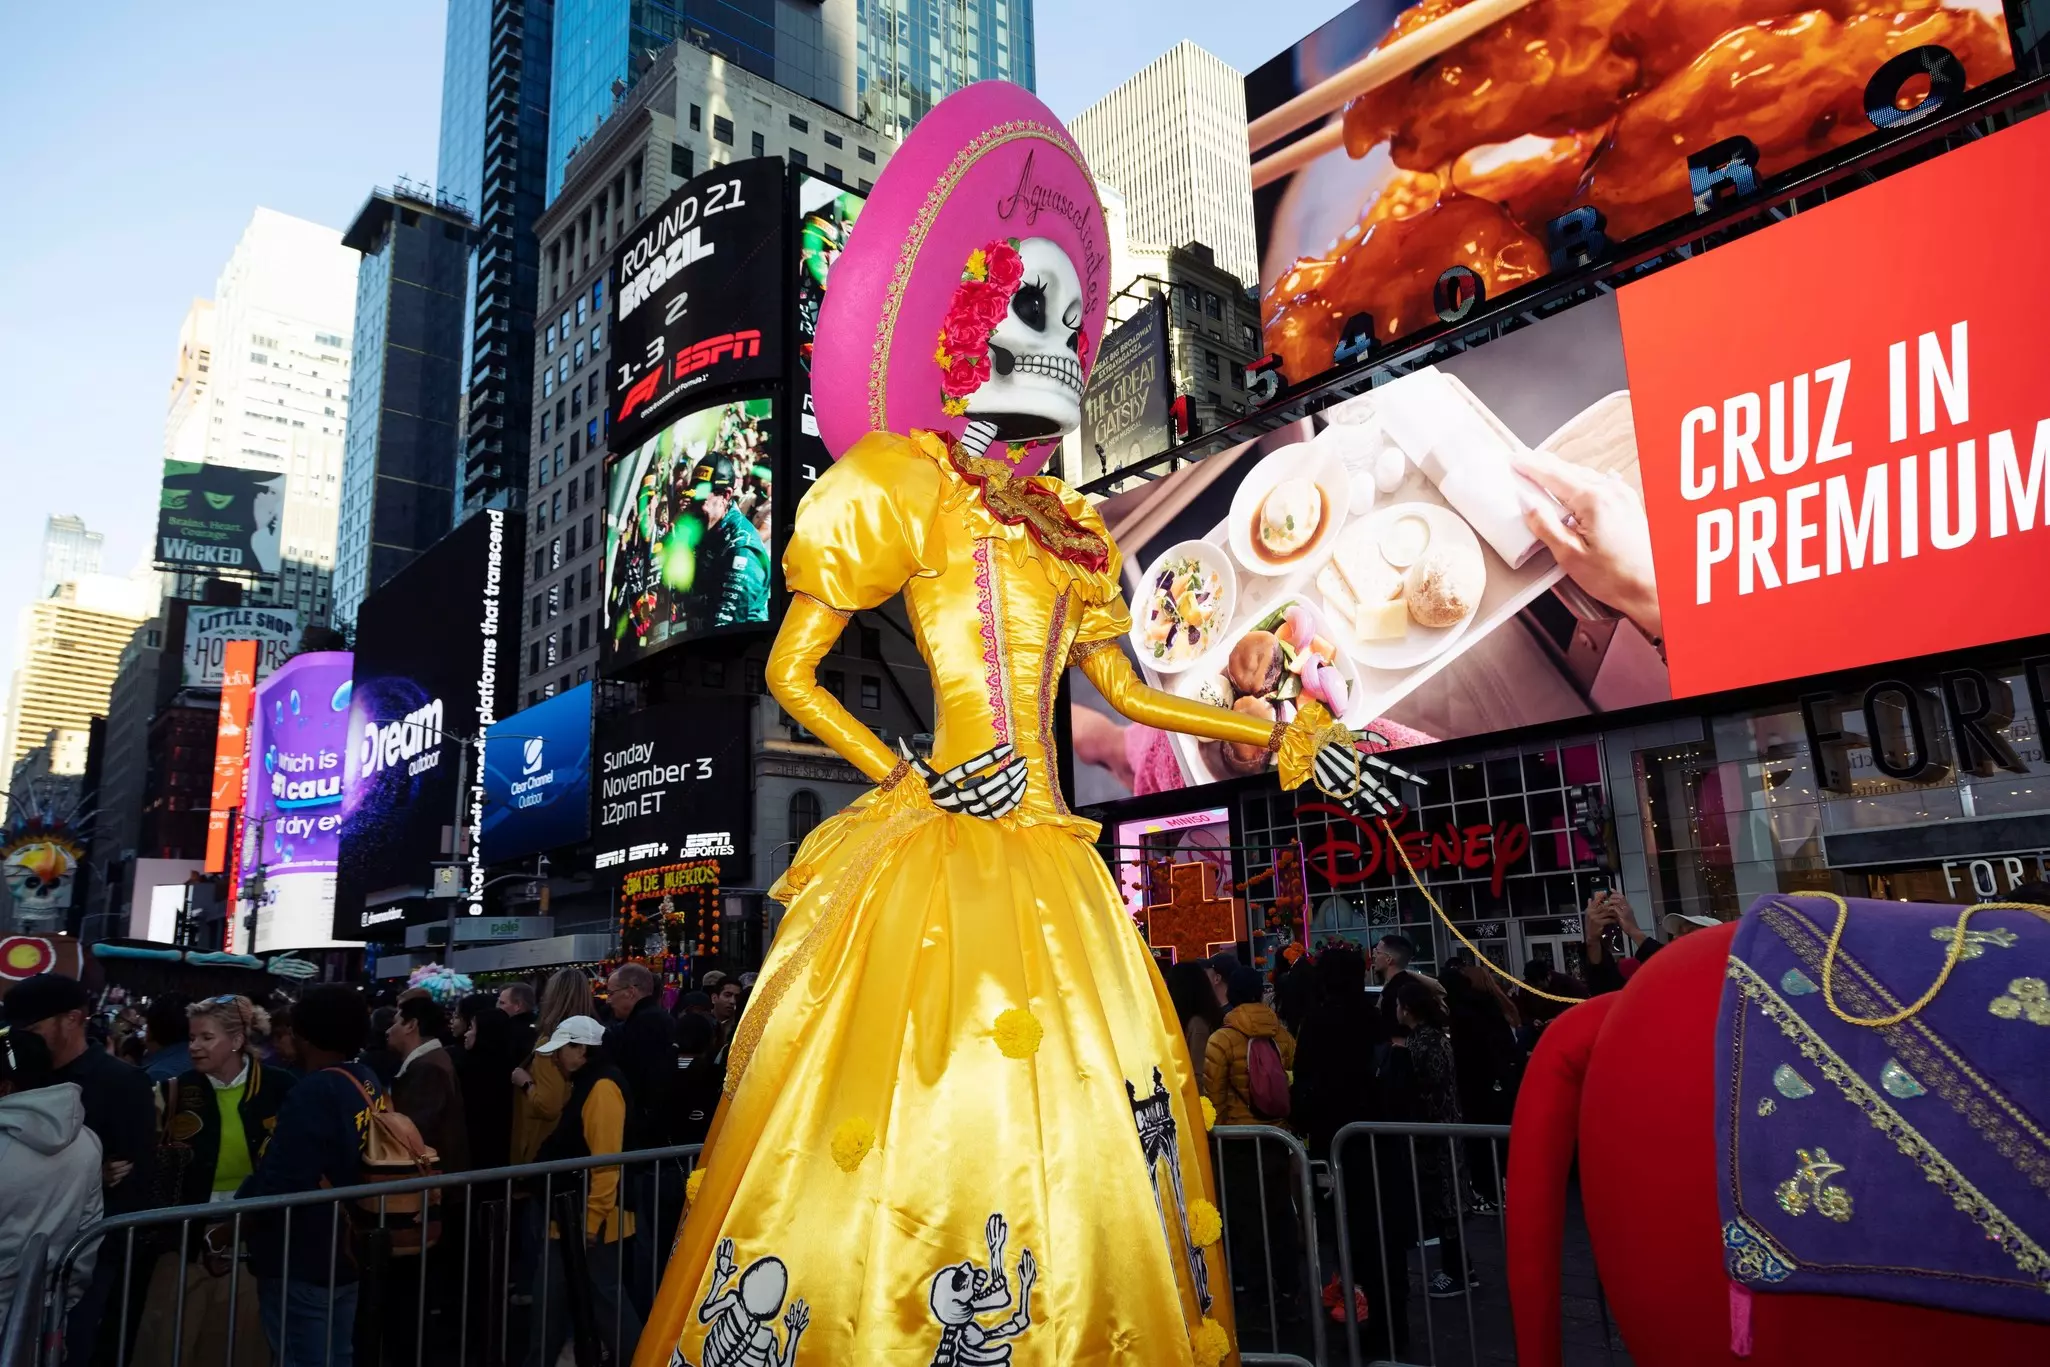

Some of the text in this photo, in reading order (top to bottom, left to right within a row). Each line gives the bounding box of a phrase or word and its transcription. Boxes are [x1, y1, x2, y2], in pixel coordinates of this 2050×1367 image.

[621, 179, 746, 283] ROUND 21
[997, 149, 1105, 315] Aguascalientes
[619, 226, 715, 322] BRAZIL
[664, 291, 688, 326] 2
[675, 329, 761, 380] ESPN
[1120, 322, 1153, 353] BROADWAY
[1098, 342, 1142, 379] EXTRAVAGANZA
[1086, 354, 1156, 426] THE GREAT
[1095, 386, 1149, 443] GATSBY
[1680, 320, 1969, 501] CRUZ IN
[1120, 421, 1142, 439] MUSICAL
[1696, 417, 2050, 605] PREMIUM
[483, 508, 504, 597] transcend
[198, 610, 293, 637] LITTLE SHOP
[480, 599, 500, 636] that
[475, 638, 498, 724] platforms
[361, 698, 443, 778] Dream
[278, 748, 338, 772] which is
[408, 751, 441, 776] outdoor
[603, 741, 654, 773] Sunday
[287, 776, 342, 800] cau
[511, 769, 554, 796] Clear Channel
[603, 757, 713, 799] November 3
[518, 792, 544, 809] Outdoor
[601, 790, 666, 826] 12pm ET
[286, 816, 316, 839] dry
[1166, 814, 1211, 828] MINISO
[680, 845, 735, 858] DEPORTES
[685, 832, 731, 848] ESPN
[643, 874, 660, 892] DE
[664, 866, 716, 889] MUERTOS
